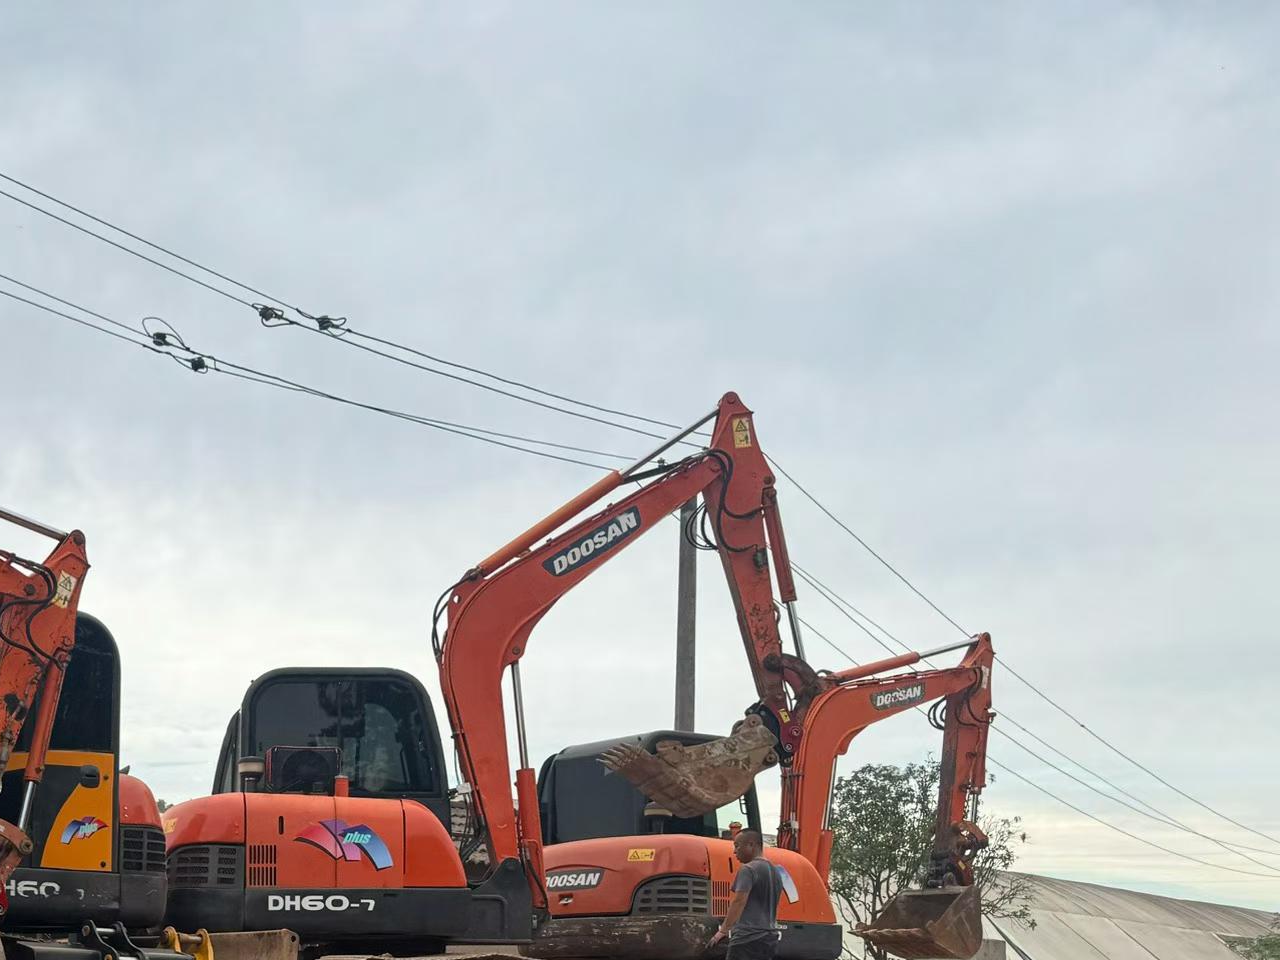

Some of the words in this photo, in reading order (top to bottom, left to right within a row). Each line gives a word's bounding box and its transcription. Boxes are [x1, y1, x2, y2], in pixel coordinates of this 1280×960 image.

[553, 511, 637, 575] DOOSAN
[876, 685, 921, 707] DOOSAN
[342, 831, 372, 844] plus
[268, 895, 375, 911] DH60-7
